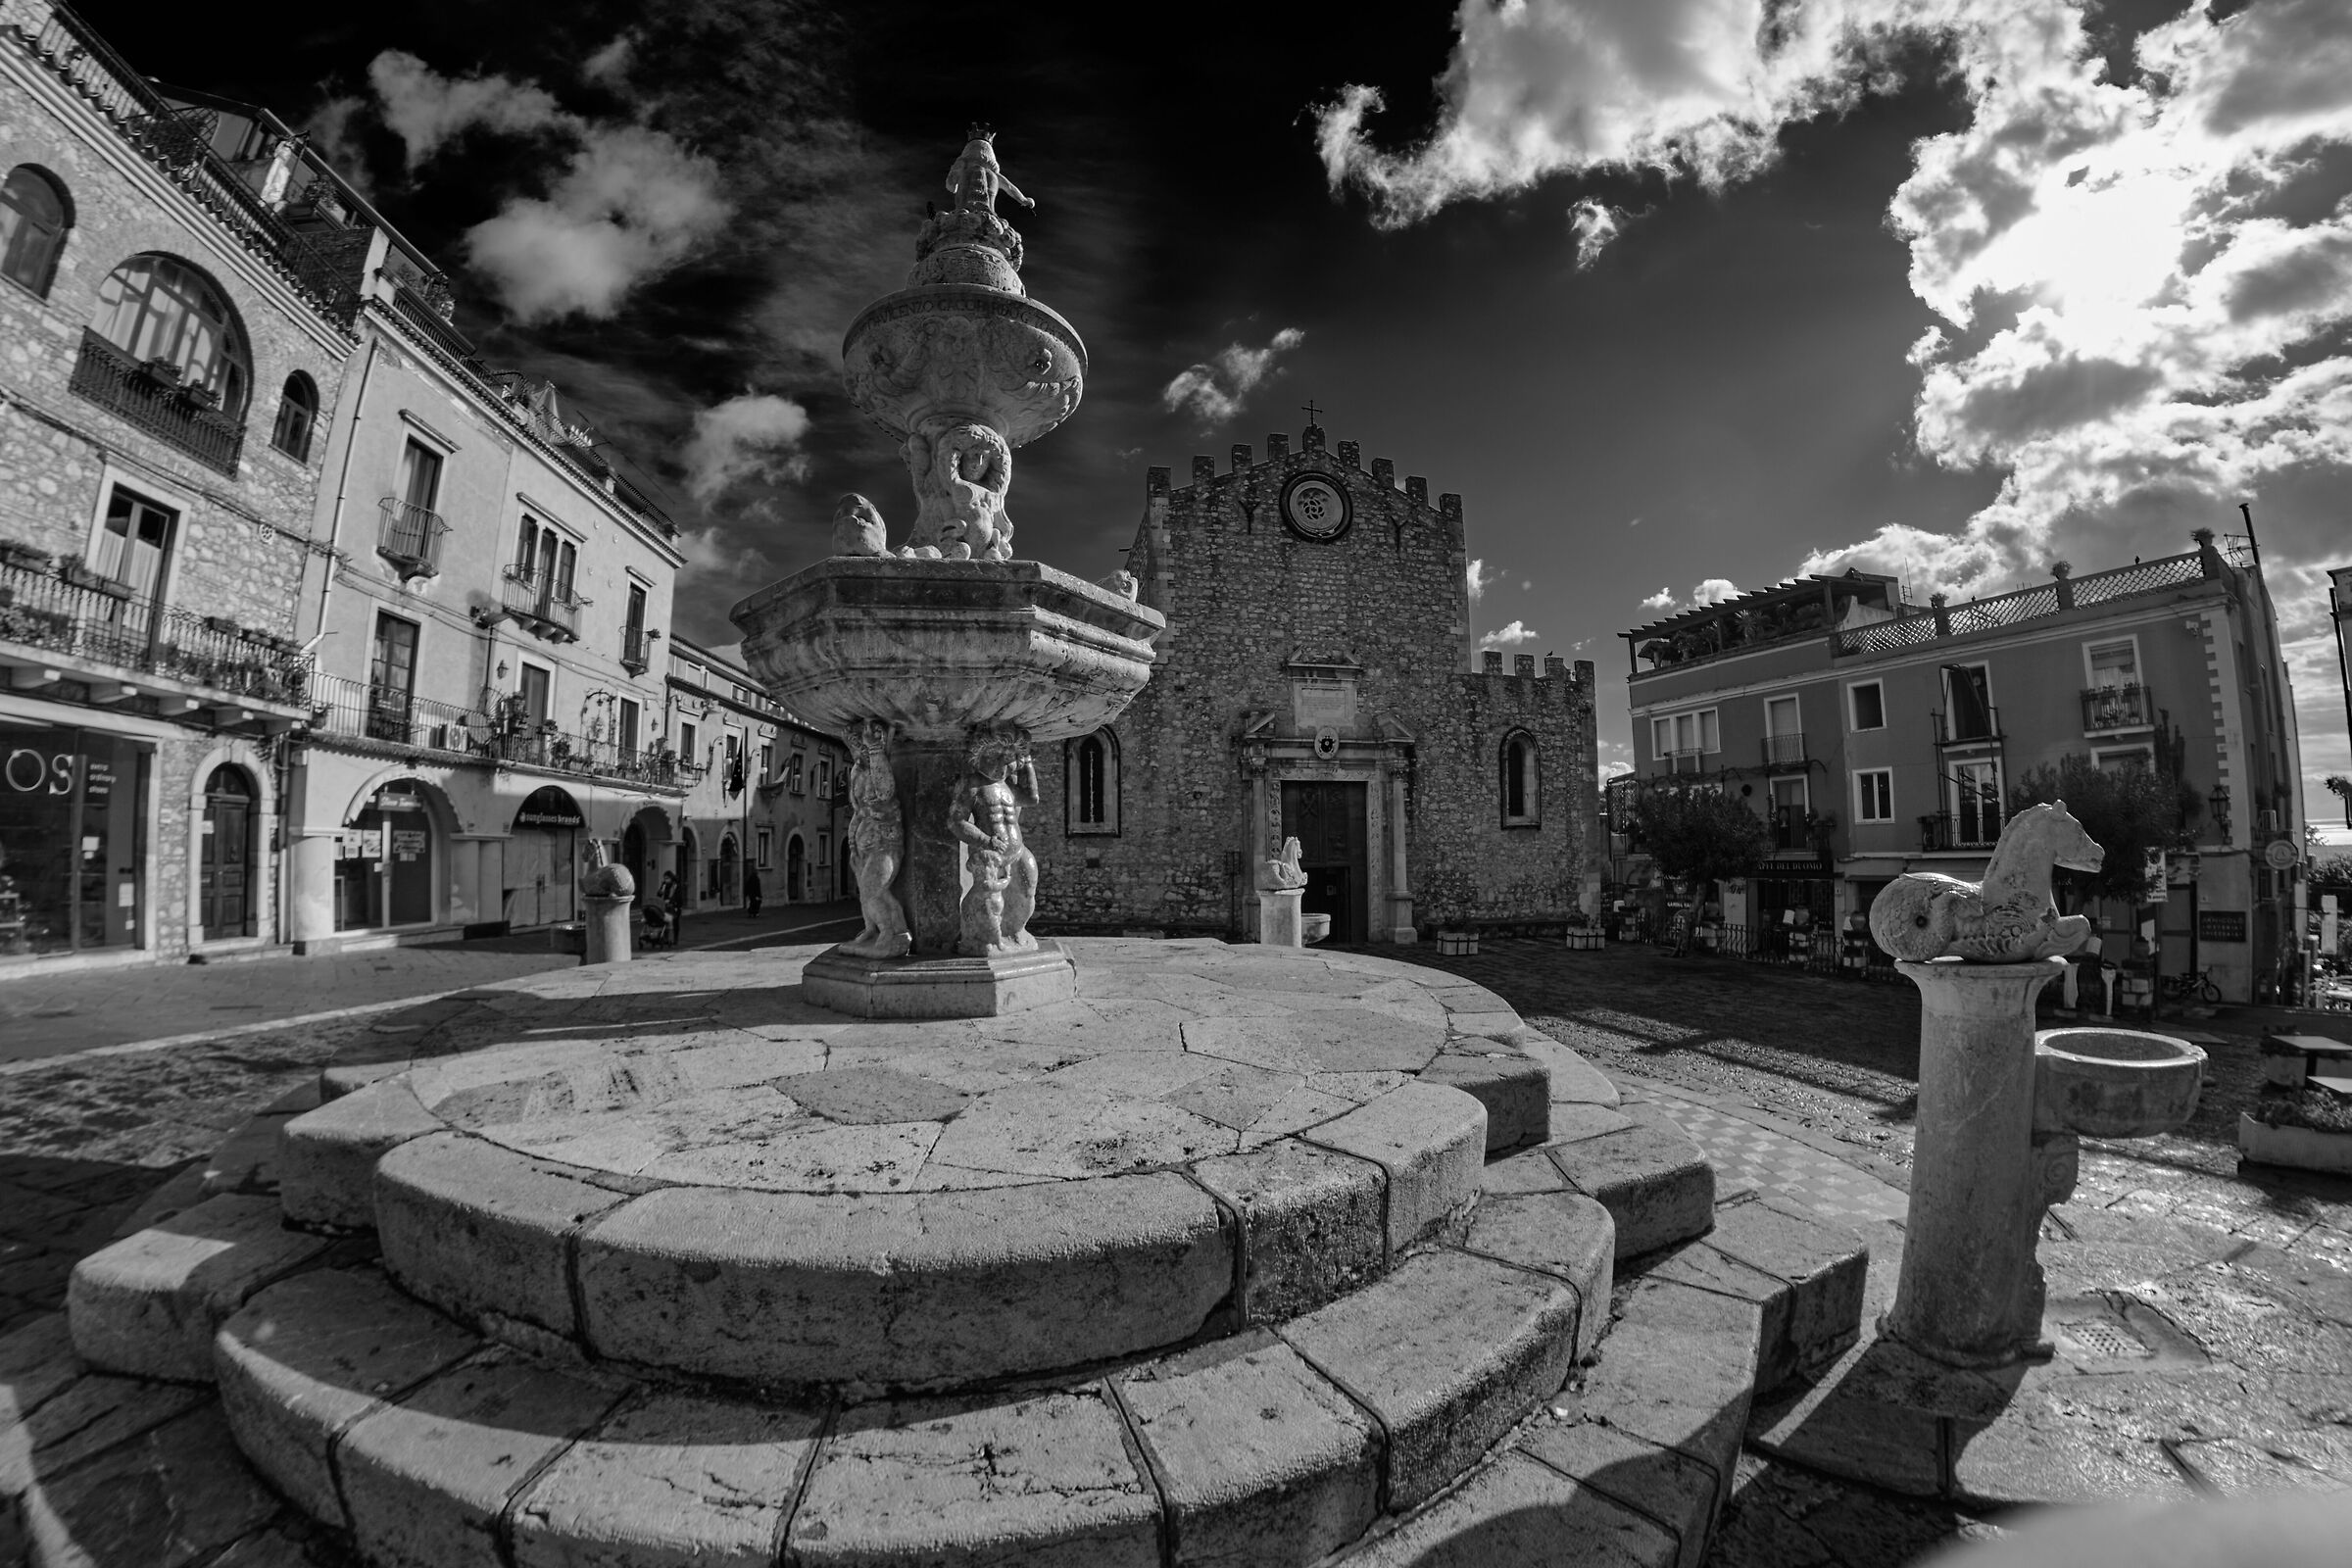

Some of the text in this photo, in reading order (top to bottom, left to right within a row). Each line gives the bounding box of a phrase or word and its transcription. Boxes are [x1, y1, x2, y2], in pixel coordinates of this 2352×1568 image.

[526, 812, 558, 824] sunglasses
[1776, 861, 1789, 870] DEL
[1792, 861, 1823, 870] DUOMO
